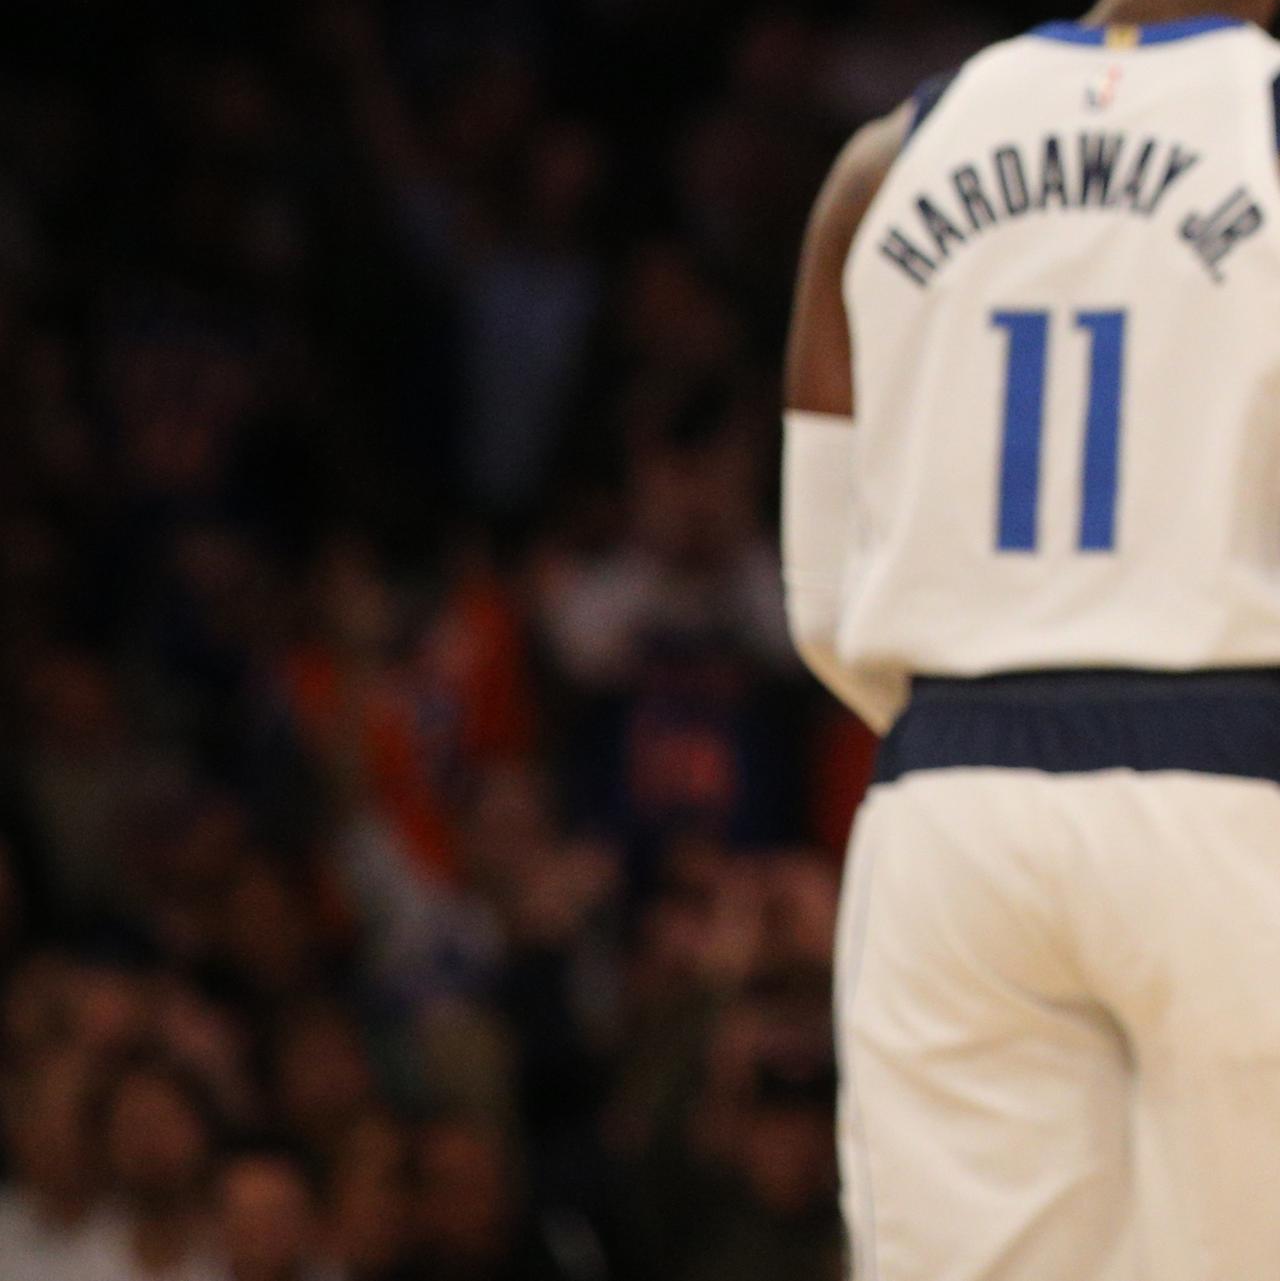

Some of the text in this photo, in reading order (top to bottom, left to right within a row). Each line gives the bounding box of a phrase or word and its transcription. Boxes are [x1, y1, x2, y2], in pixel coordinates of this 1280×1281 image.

[881, 133, 1266, 286] HARDAWAY JR.
[991, 310, 1128, 553] 11
